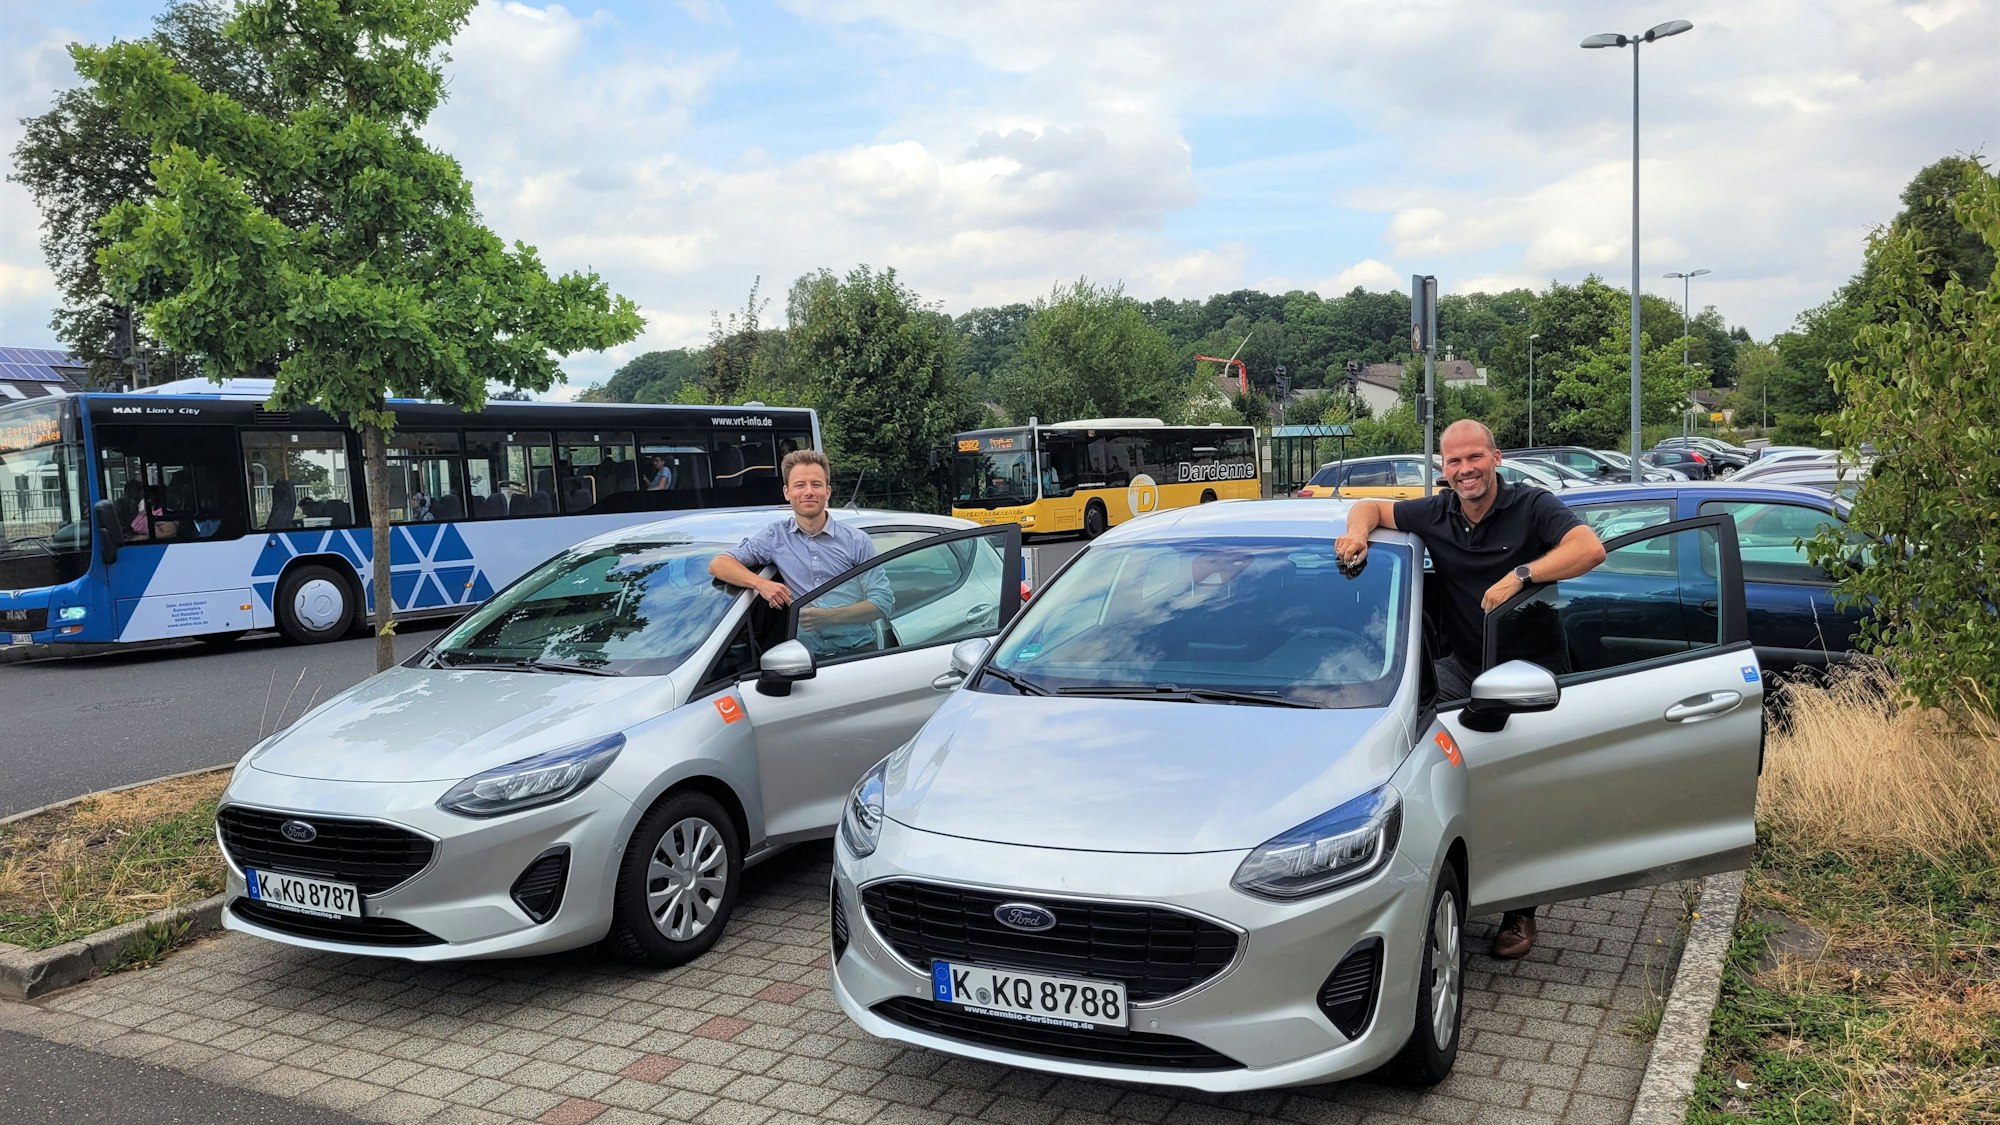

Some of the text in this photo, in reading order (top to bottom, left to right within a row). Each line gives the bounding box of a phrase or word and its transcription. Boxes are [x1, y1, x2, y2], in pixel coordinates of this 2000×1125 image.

[178, 407, 200, 416] City
[711, 416, 773, 427] www.vrt-info.de
[1178, 460, 1255, 482] Dardenne
[1136, 485, 1156, 514] D
[6, 609, 28, 621] MAN
[258, 873, 355, 912] K KQ 8787
[1007, 908, 1041, 927] Ford
[939, 985, 948, 995] D
[952, 968, 1121, 1020] K KQ 8788
[964, 1005, 1095, 1031] www.cambio-CarSharing.de
